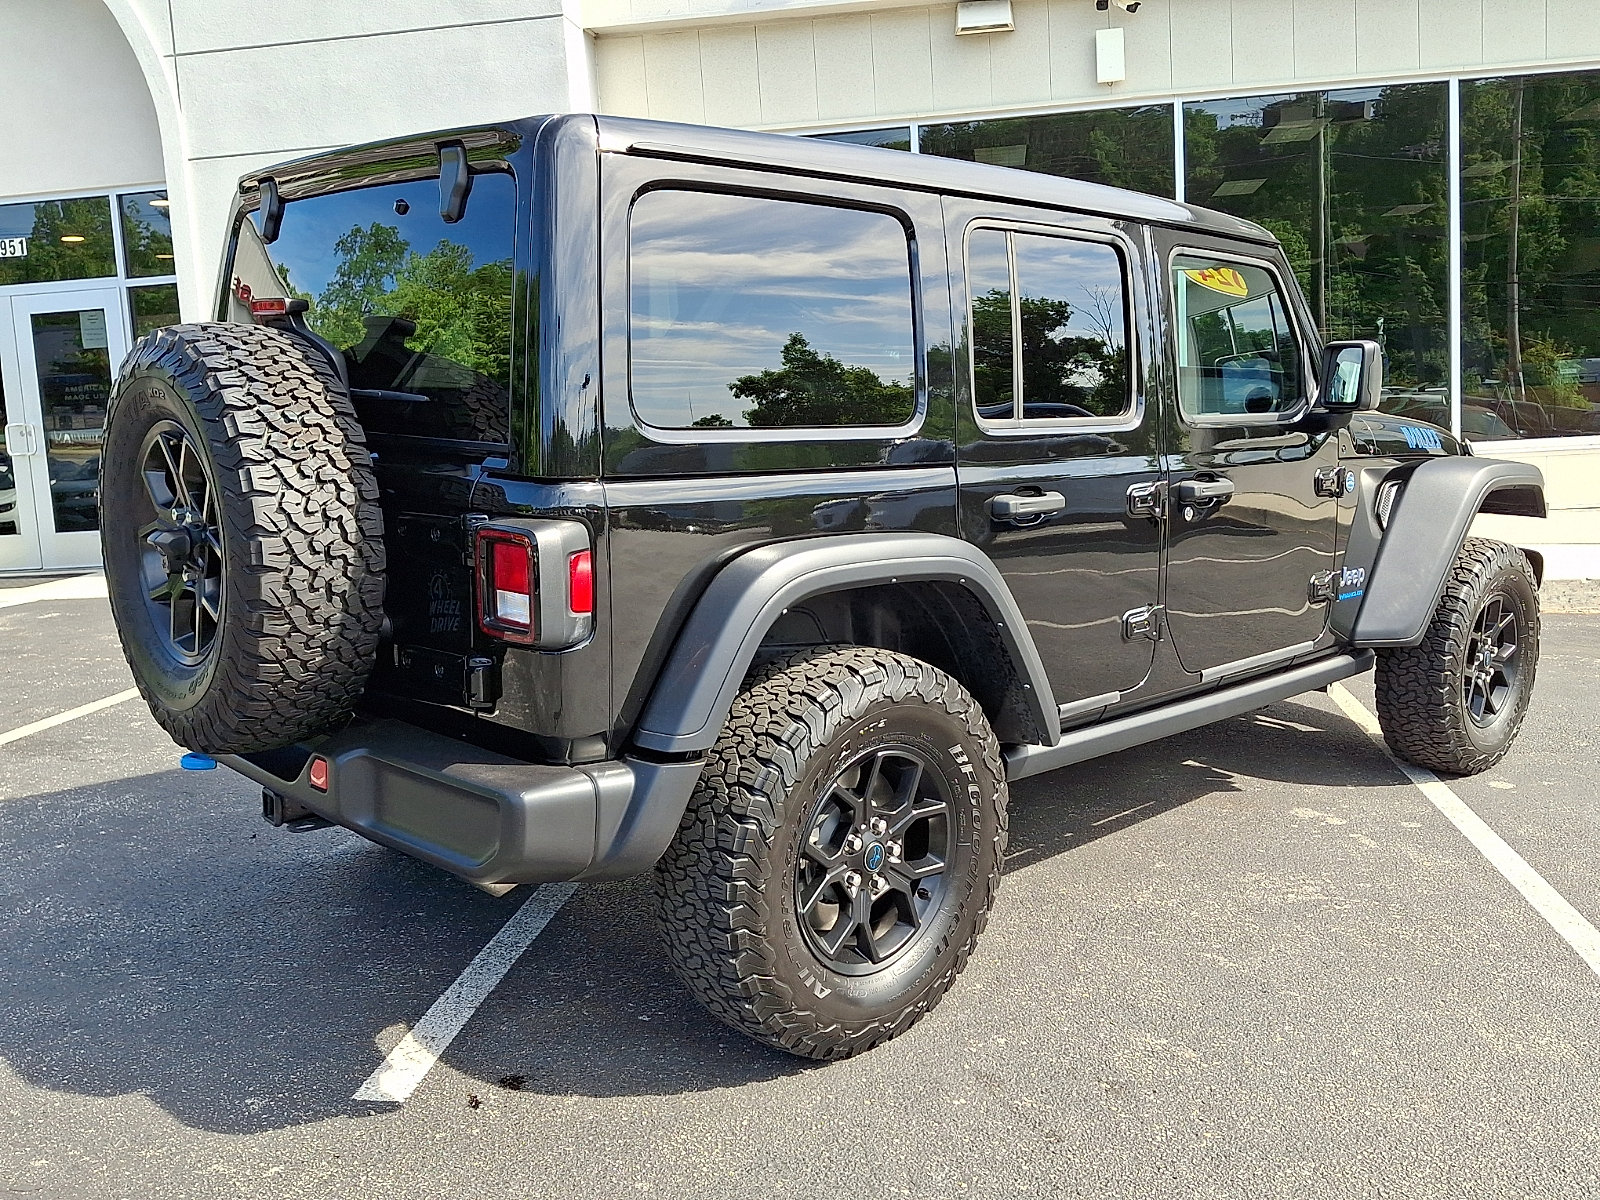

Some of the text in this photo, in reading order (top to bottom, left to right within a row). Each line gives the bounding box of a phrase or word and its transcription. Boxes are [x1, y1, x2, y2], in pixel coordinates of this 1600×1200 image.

[1, 239, 25, 256] 951
[1340, 565, 1365, 588] Jeep
[429, 599, 461, 615] WHEEL
[431, 616, 461, 632] DRIVE
